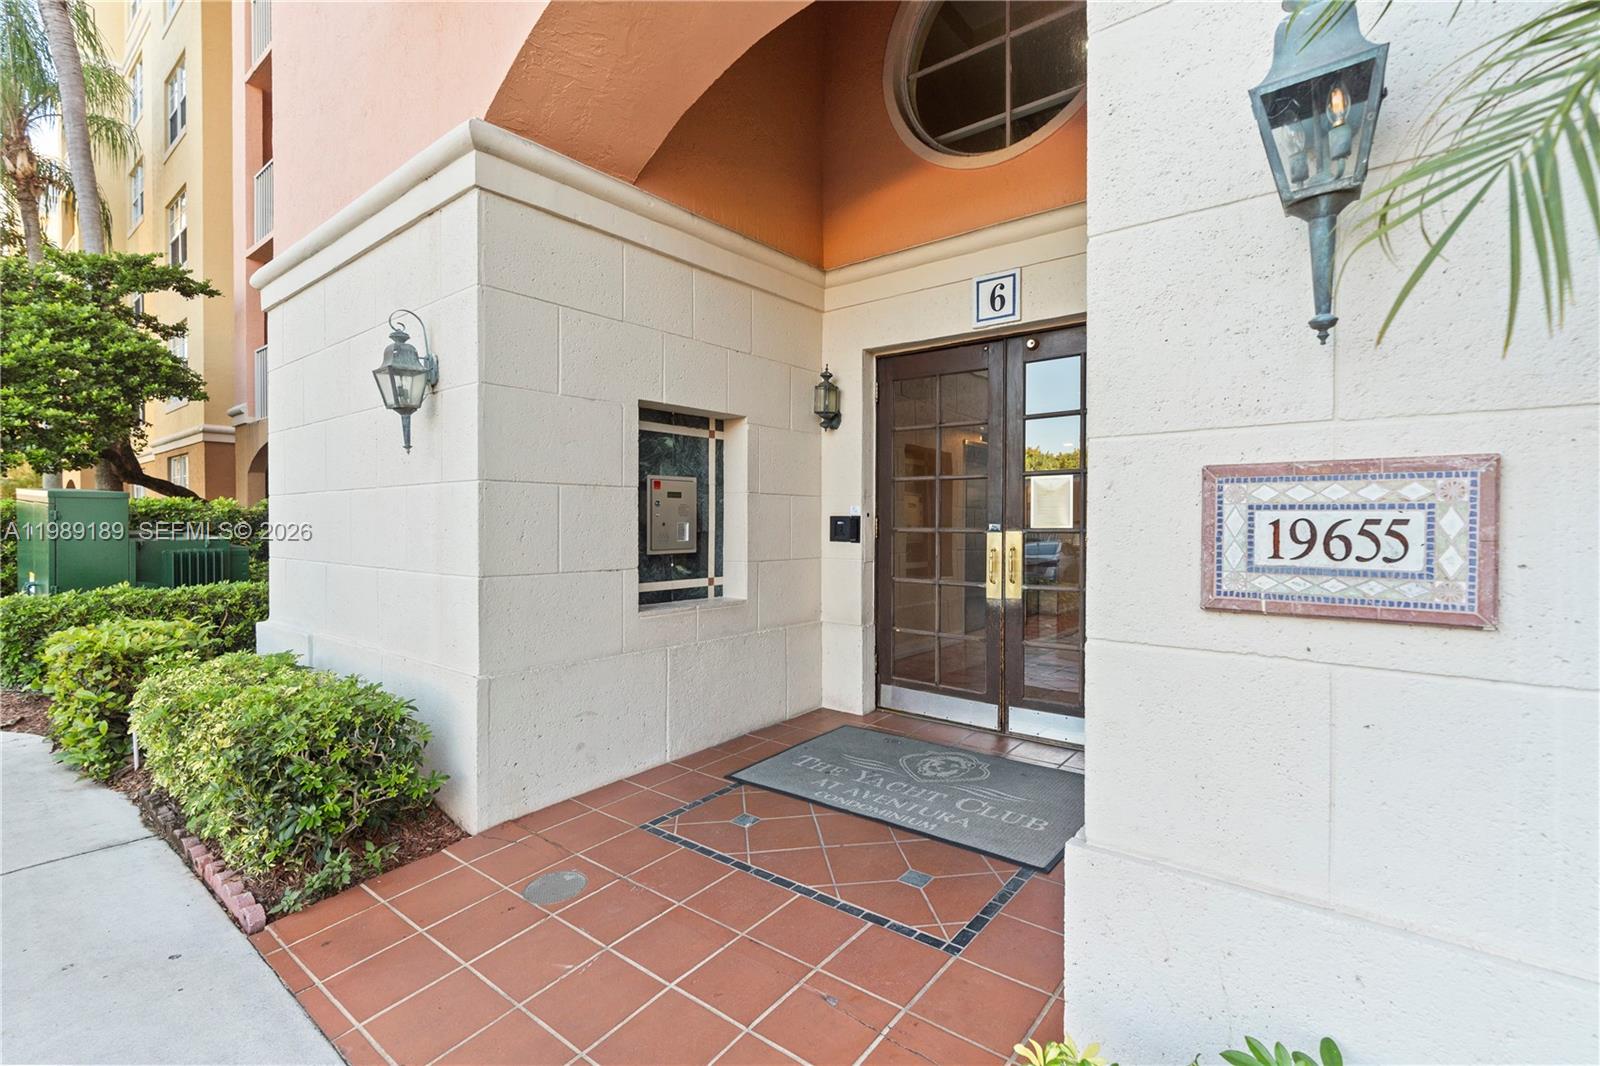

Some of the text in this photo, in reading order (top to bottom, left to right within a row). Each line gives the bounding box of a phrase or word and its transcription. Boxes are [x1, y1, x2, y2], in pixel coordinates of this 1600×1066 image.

[990, 283, 1006, 312] 6
[1267, 517, 1411, 564] 19655
[792, 755, 1049, 831] THE YACHT CLUB
[811, 778, 969, 828] AT AVENTURA
